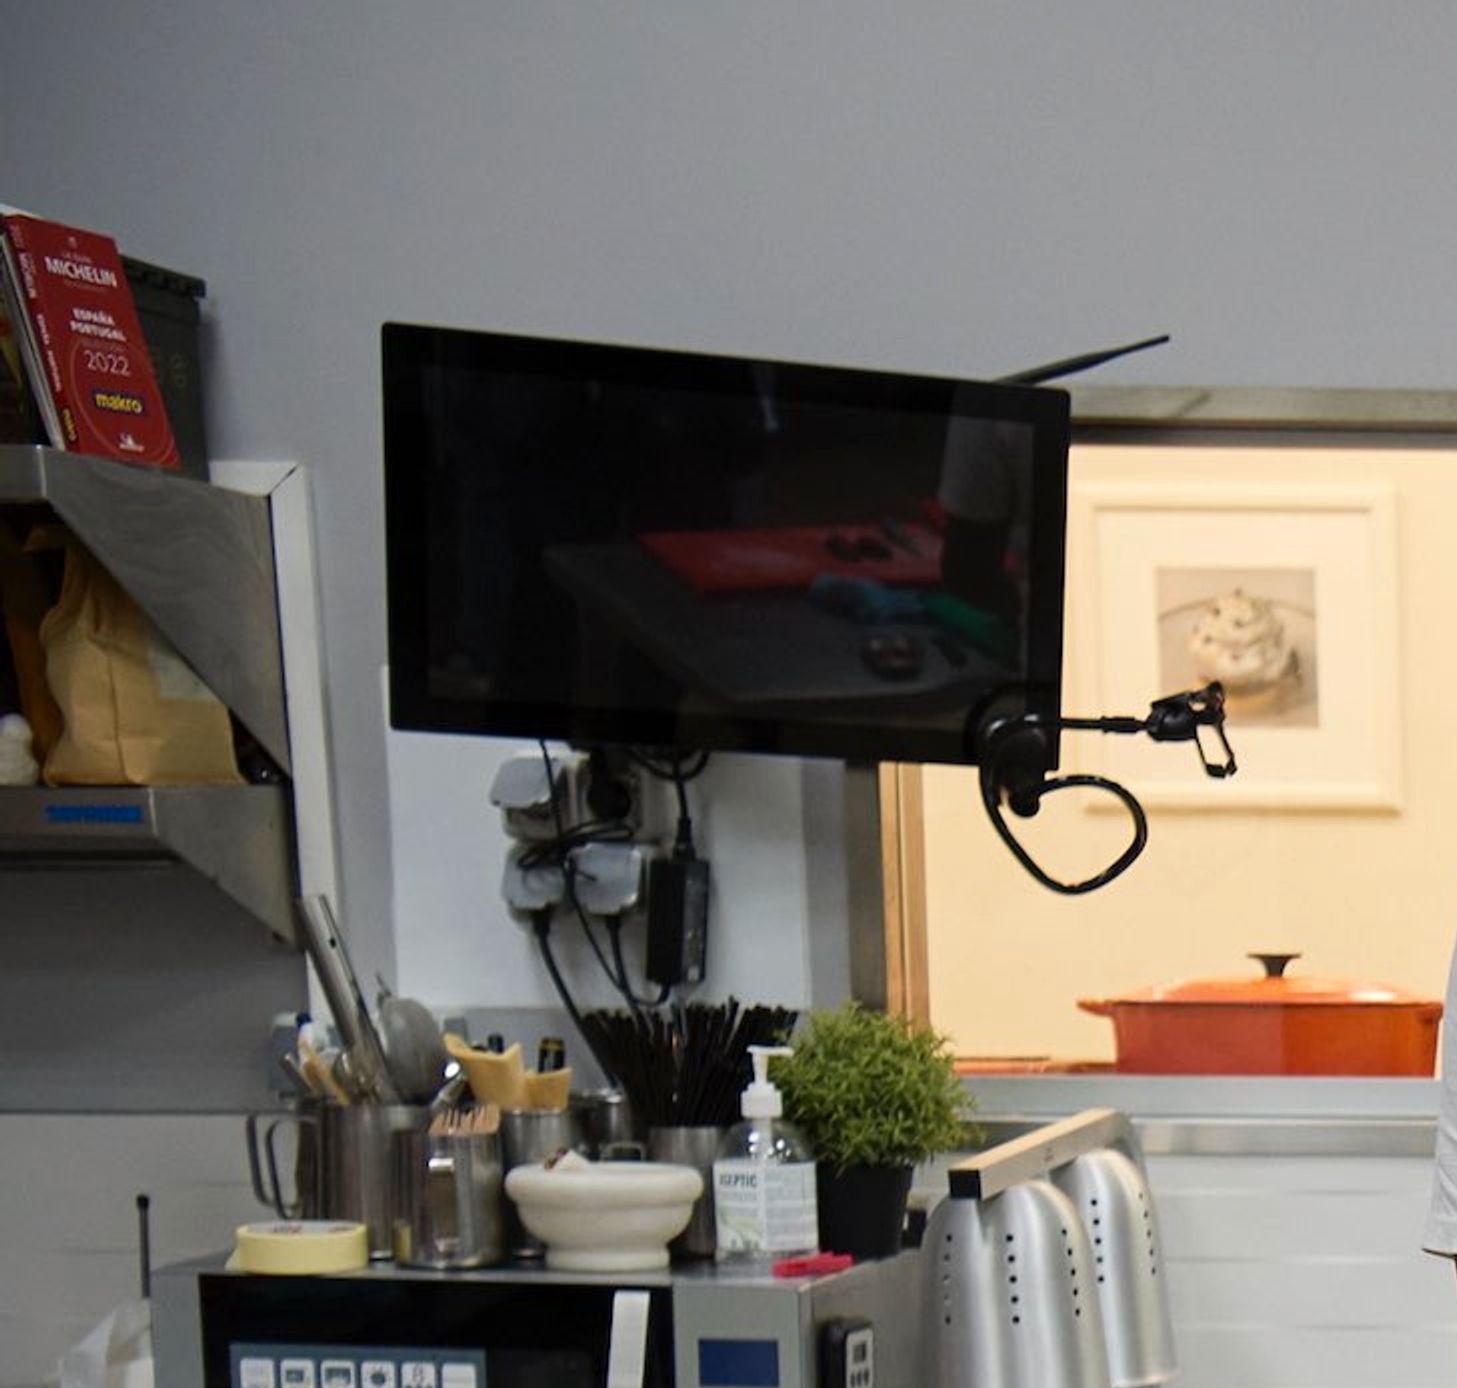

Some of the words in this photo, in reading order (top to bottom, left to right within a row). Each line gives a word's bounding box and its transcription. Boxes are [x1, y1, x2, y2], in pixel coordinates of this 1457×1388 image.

[44, 256, 118, 288] MICHELIN
[69, 320, 127, 342] PORTUGAL
[84, 350, 131, 376] 2022
[95, 393, 143, 413] makro
